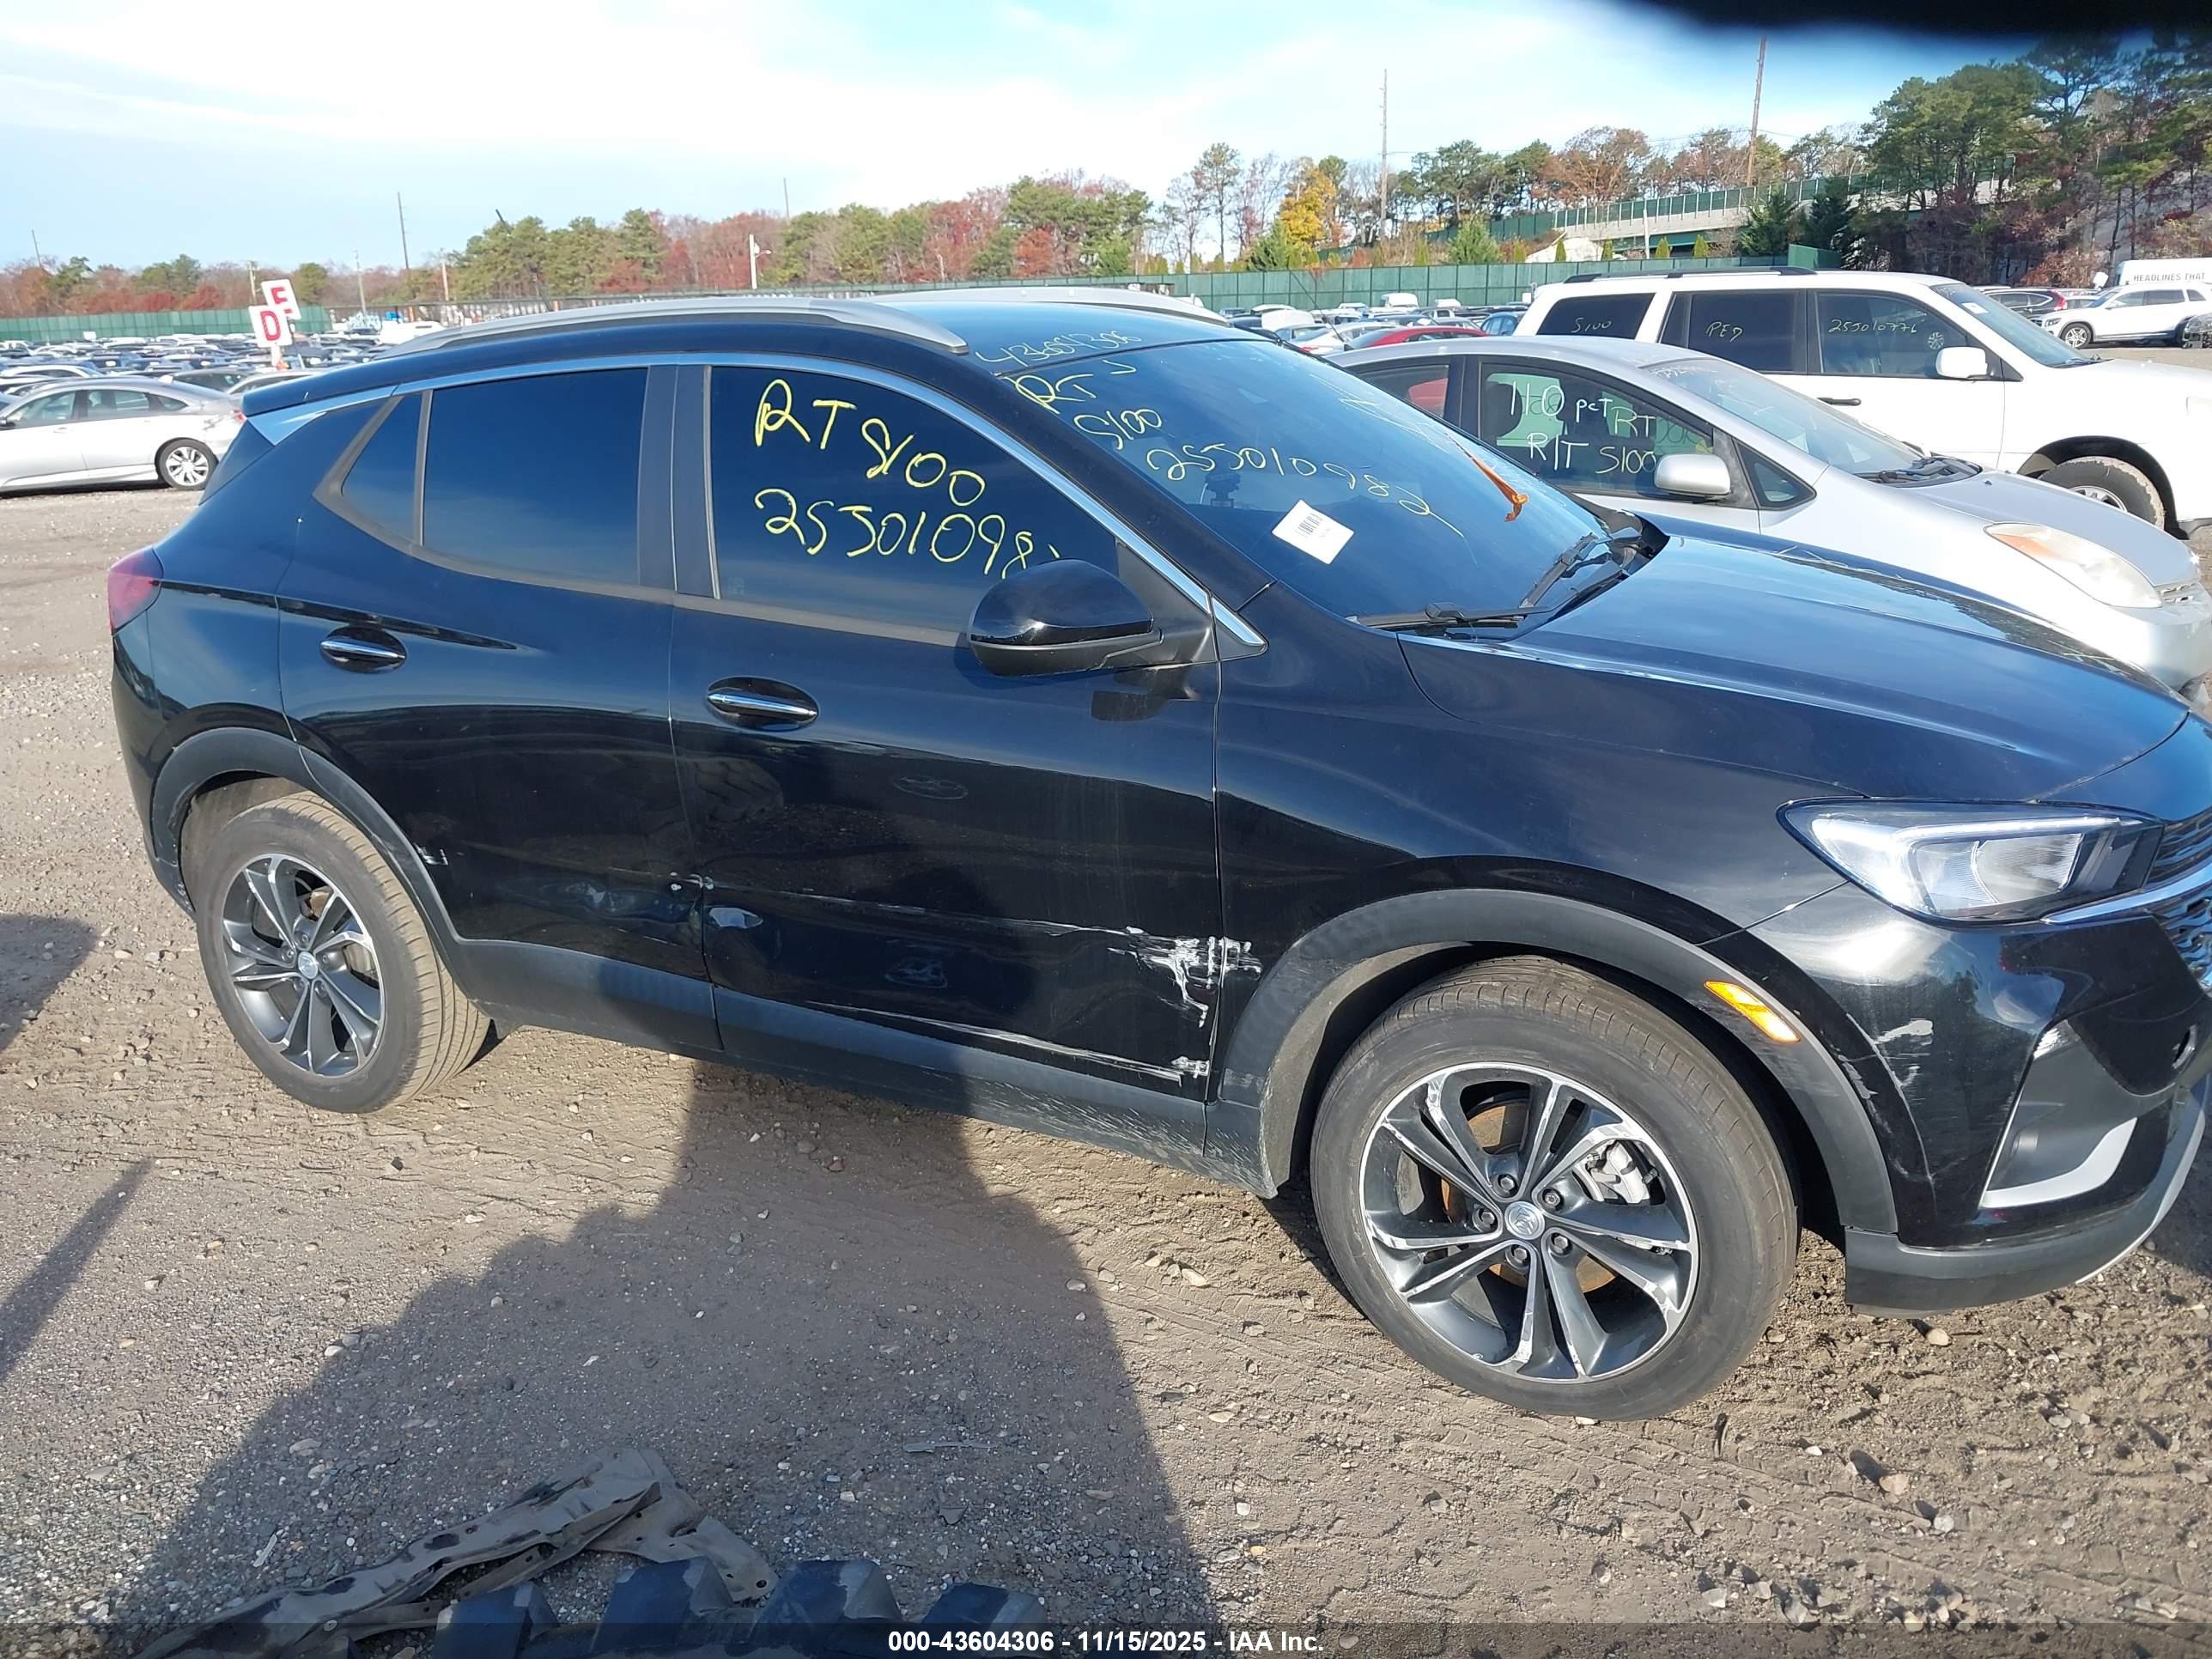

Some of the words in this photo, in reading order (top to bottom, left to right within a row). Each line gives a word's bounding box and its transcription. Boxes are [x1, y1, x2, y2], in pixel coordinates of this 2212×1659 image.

[2133, 273, 2181, 282] HEADLINES
[2185, 272, 2205, 281] THAT
[260, 310, 281, 341] D
[1571, 317, 1613, 333] S100
[754, 379, 857, 449] RT
[1073, 409, 1163, 450] S100
[1611, 405, 1656, 438] RT
[754, 489, 1062, 580] 25501098
